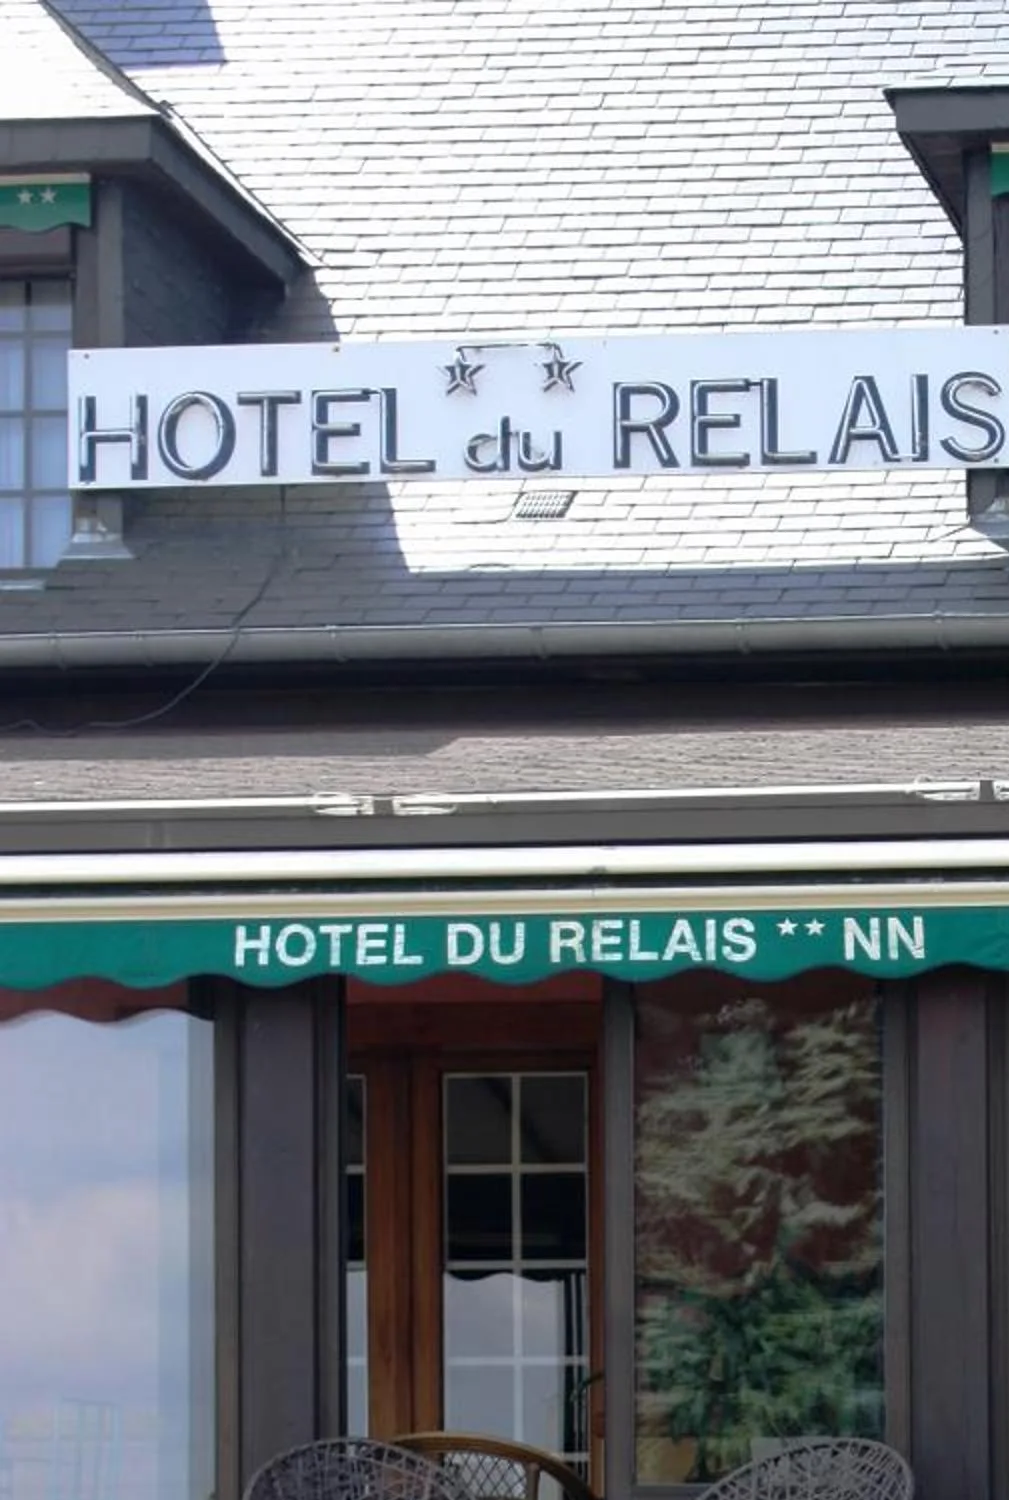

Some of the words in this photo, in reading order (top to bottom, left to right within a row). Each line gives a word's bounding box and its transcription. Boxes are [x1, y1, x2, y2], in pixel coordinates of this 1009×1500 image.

[77, 386, 436, 482] HOTEL
[462, 416, 563, 472] du
[612, 371, 1006, 470] RELAIS
[234, 922, 423, 967] HOTEL
[446, 921, 525, 965] DU
[549, 917, 758, 963] RELAIS
[843, 916, 926, 961] NN
